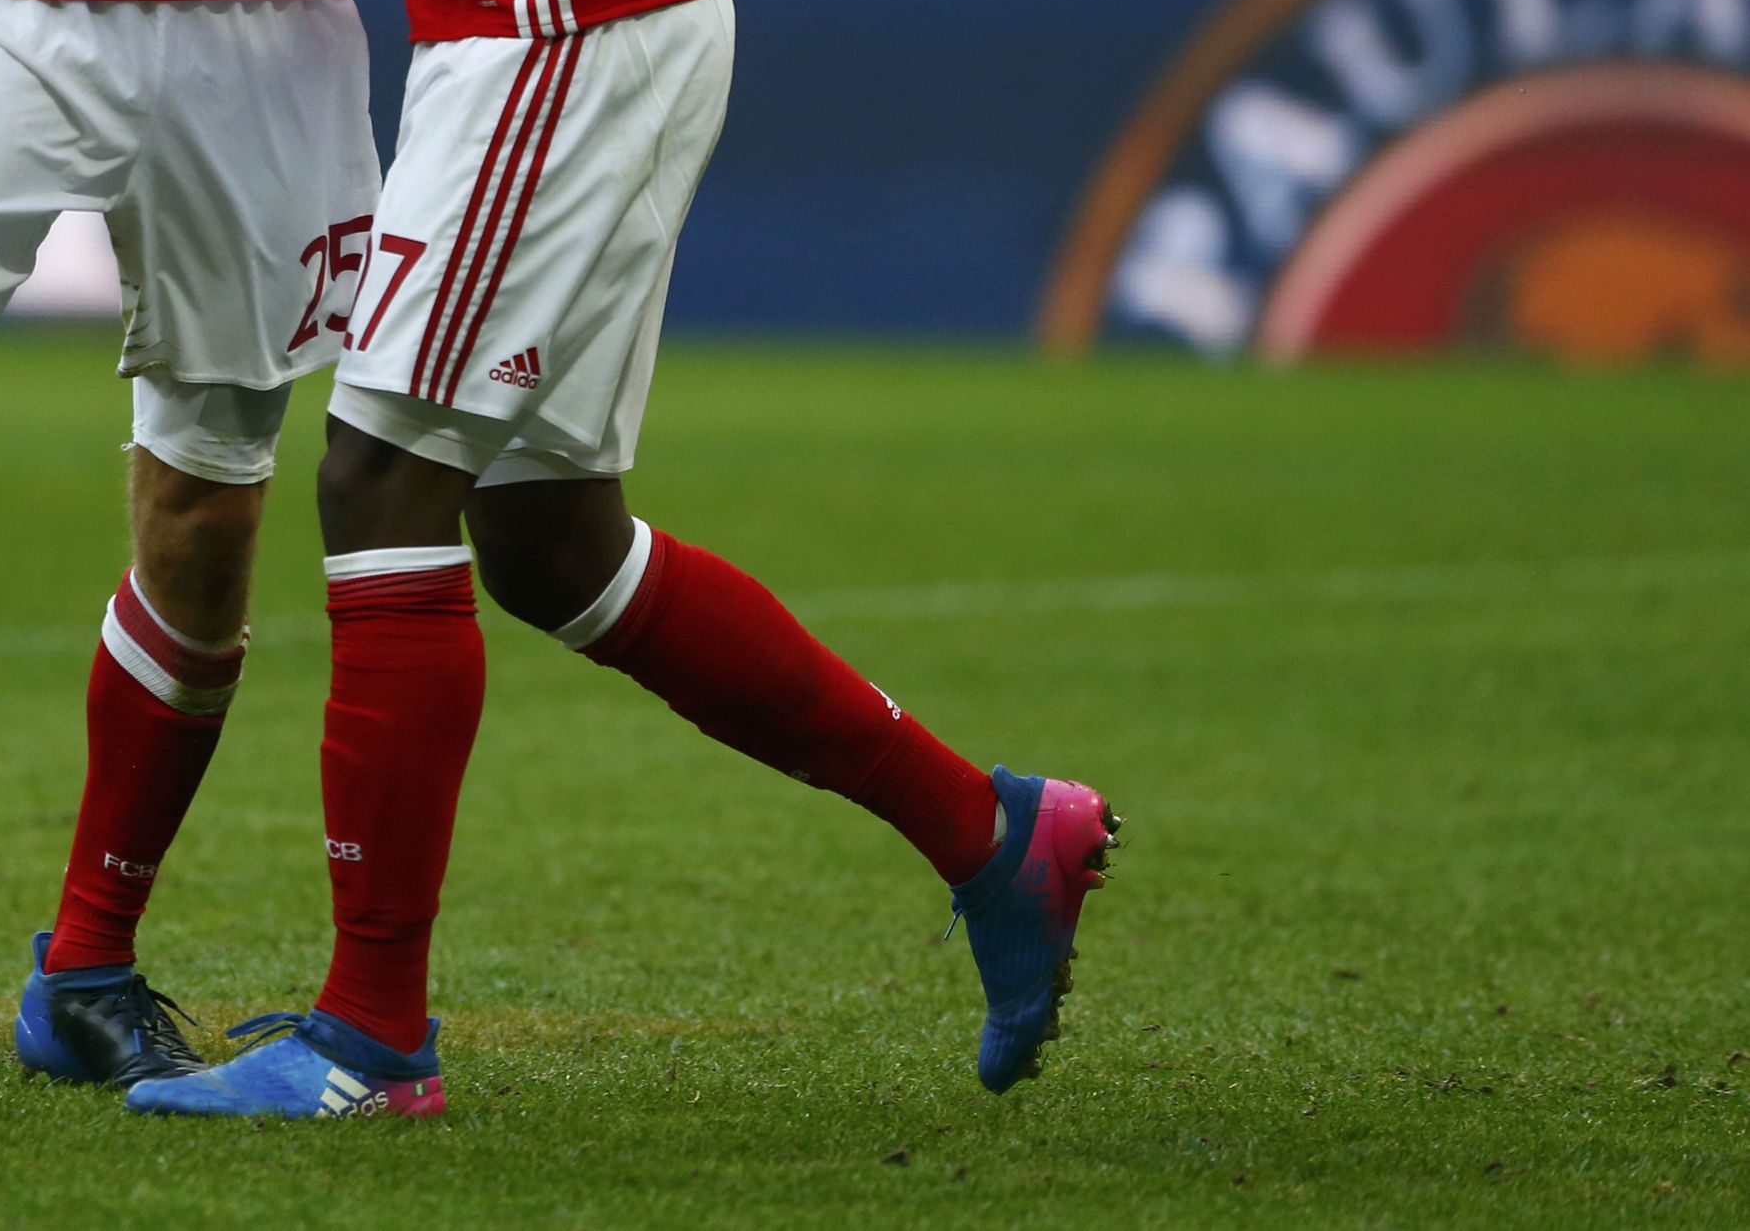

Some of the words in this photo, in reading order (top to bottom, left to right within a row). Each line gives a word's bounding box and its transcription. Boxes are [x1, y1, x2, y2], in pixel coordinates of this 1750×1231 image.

[287, 214, 374, 353] 25
[489, 368, 539, 390] adida
[324, 833, 363, 862] CB
[104, 852, 157, 880] FCB
